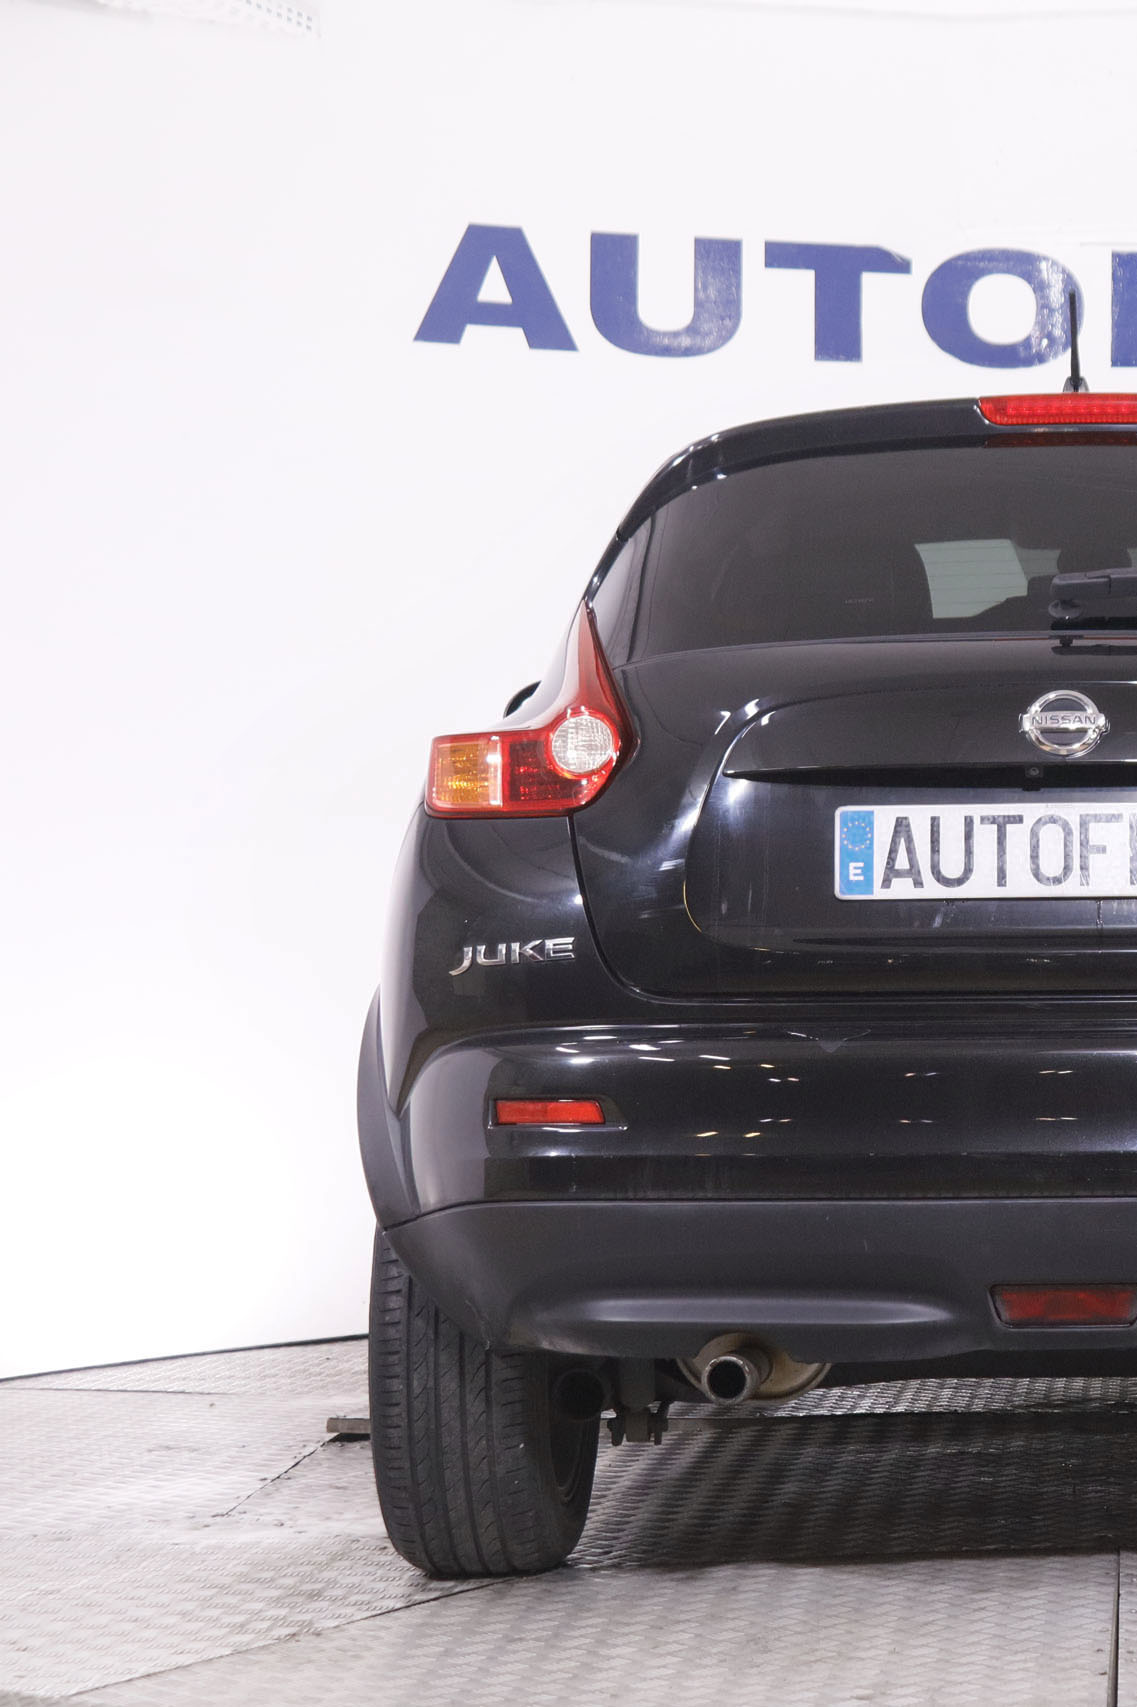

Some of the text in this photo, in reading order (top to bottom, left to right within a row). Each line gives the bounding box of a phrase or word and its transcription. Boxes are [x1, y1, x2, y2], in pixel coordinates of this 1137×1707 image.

[1030, 713, 1097, 726] NISSAN
[848, 861, 866, 881] E
[448, 936, 576, 976] JUKE
